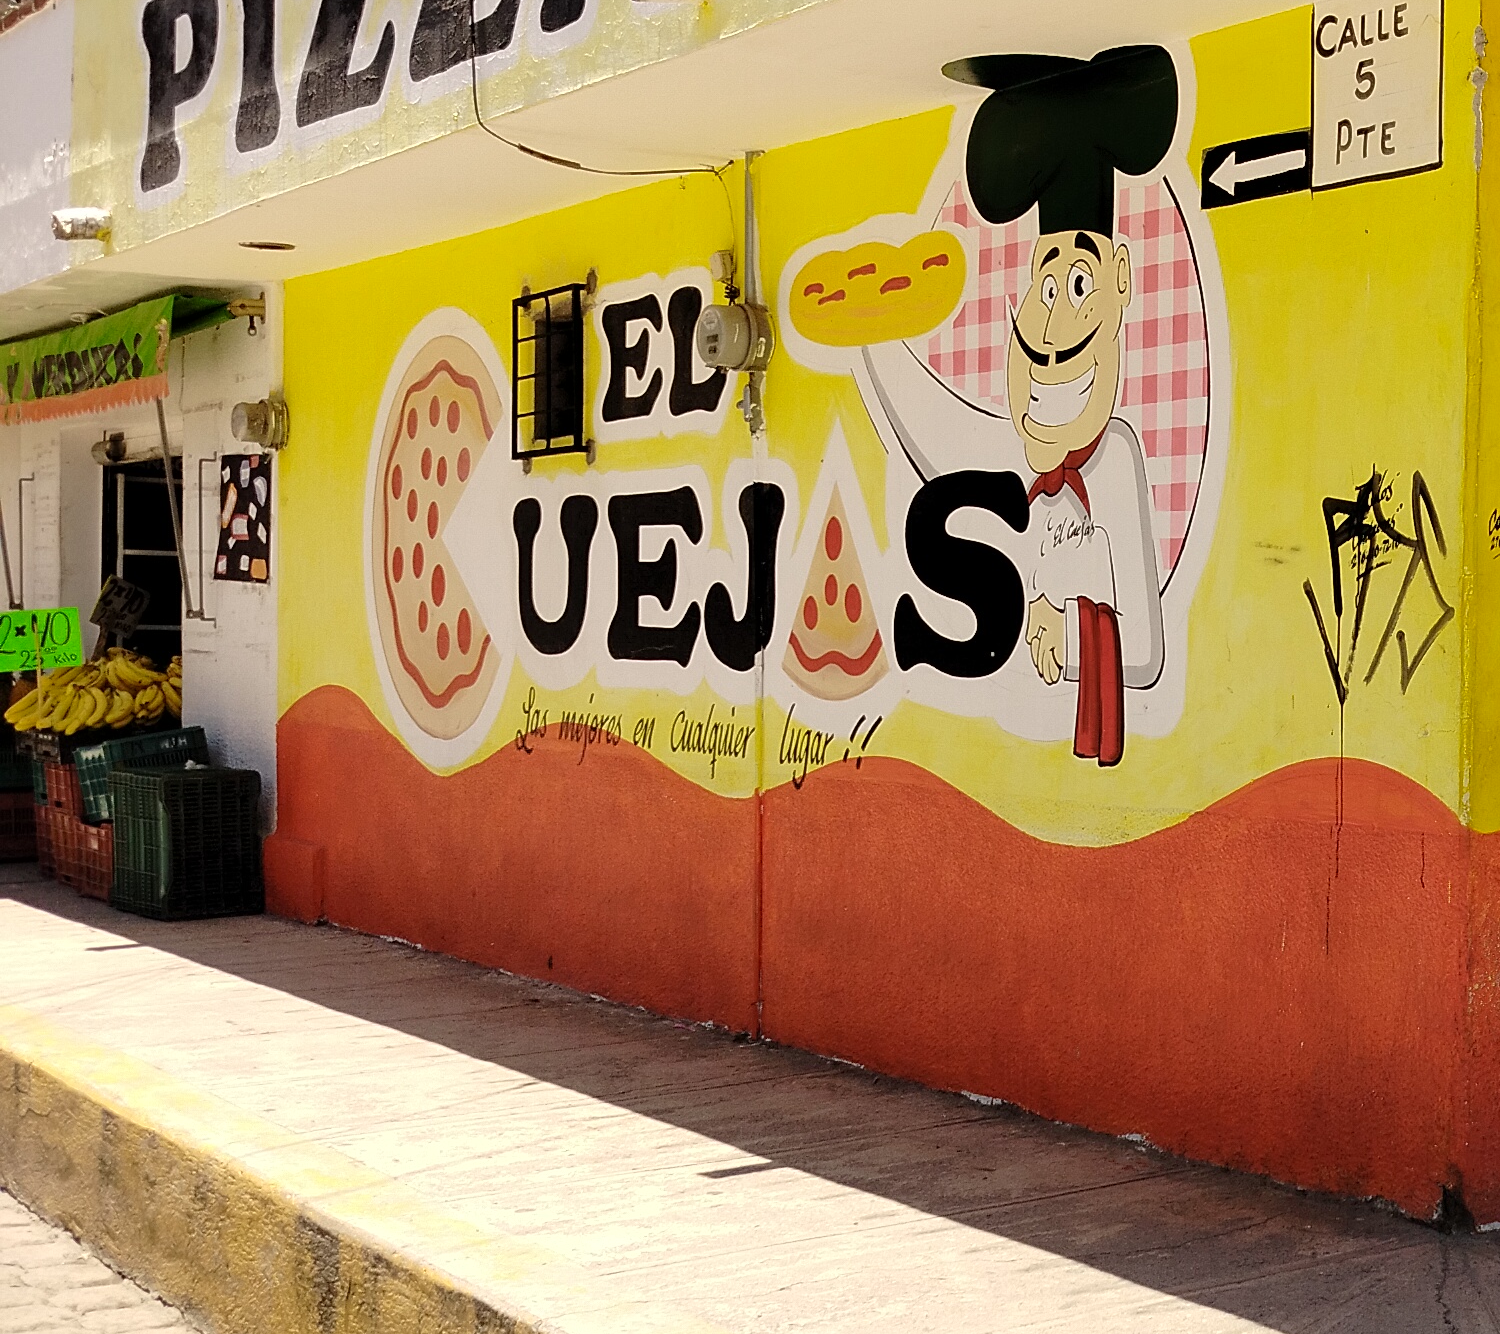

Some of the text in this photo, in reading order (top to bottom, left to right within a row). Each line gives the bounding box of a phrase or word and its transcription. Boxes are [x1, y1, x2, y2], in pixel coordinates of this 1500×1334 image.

[1316, 3, 1409, 58] CALLE
[1354, 58, 1376, 100] 5
[1336, 119, 1396, 165] PTE
[601, 285, 734, 422] EL
[515, 687, 549, 754] Las
[558, 693, 622, 766] mejores
[633, 716, 656, 749] en
[671, 703, 756, 779] Cualquier
